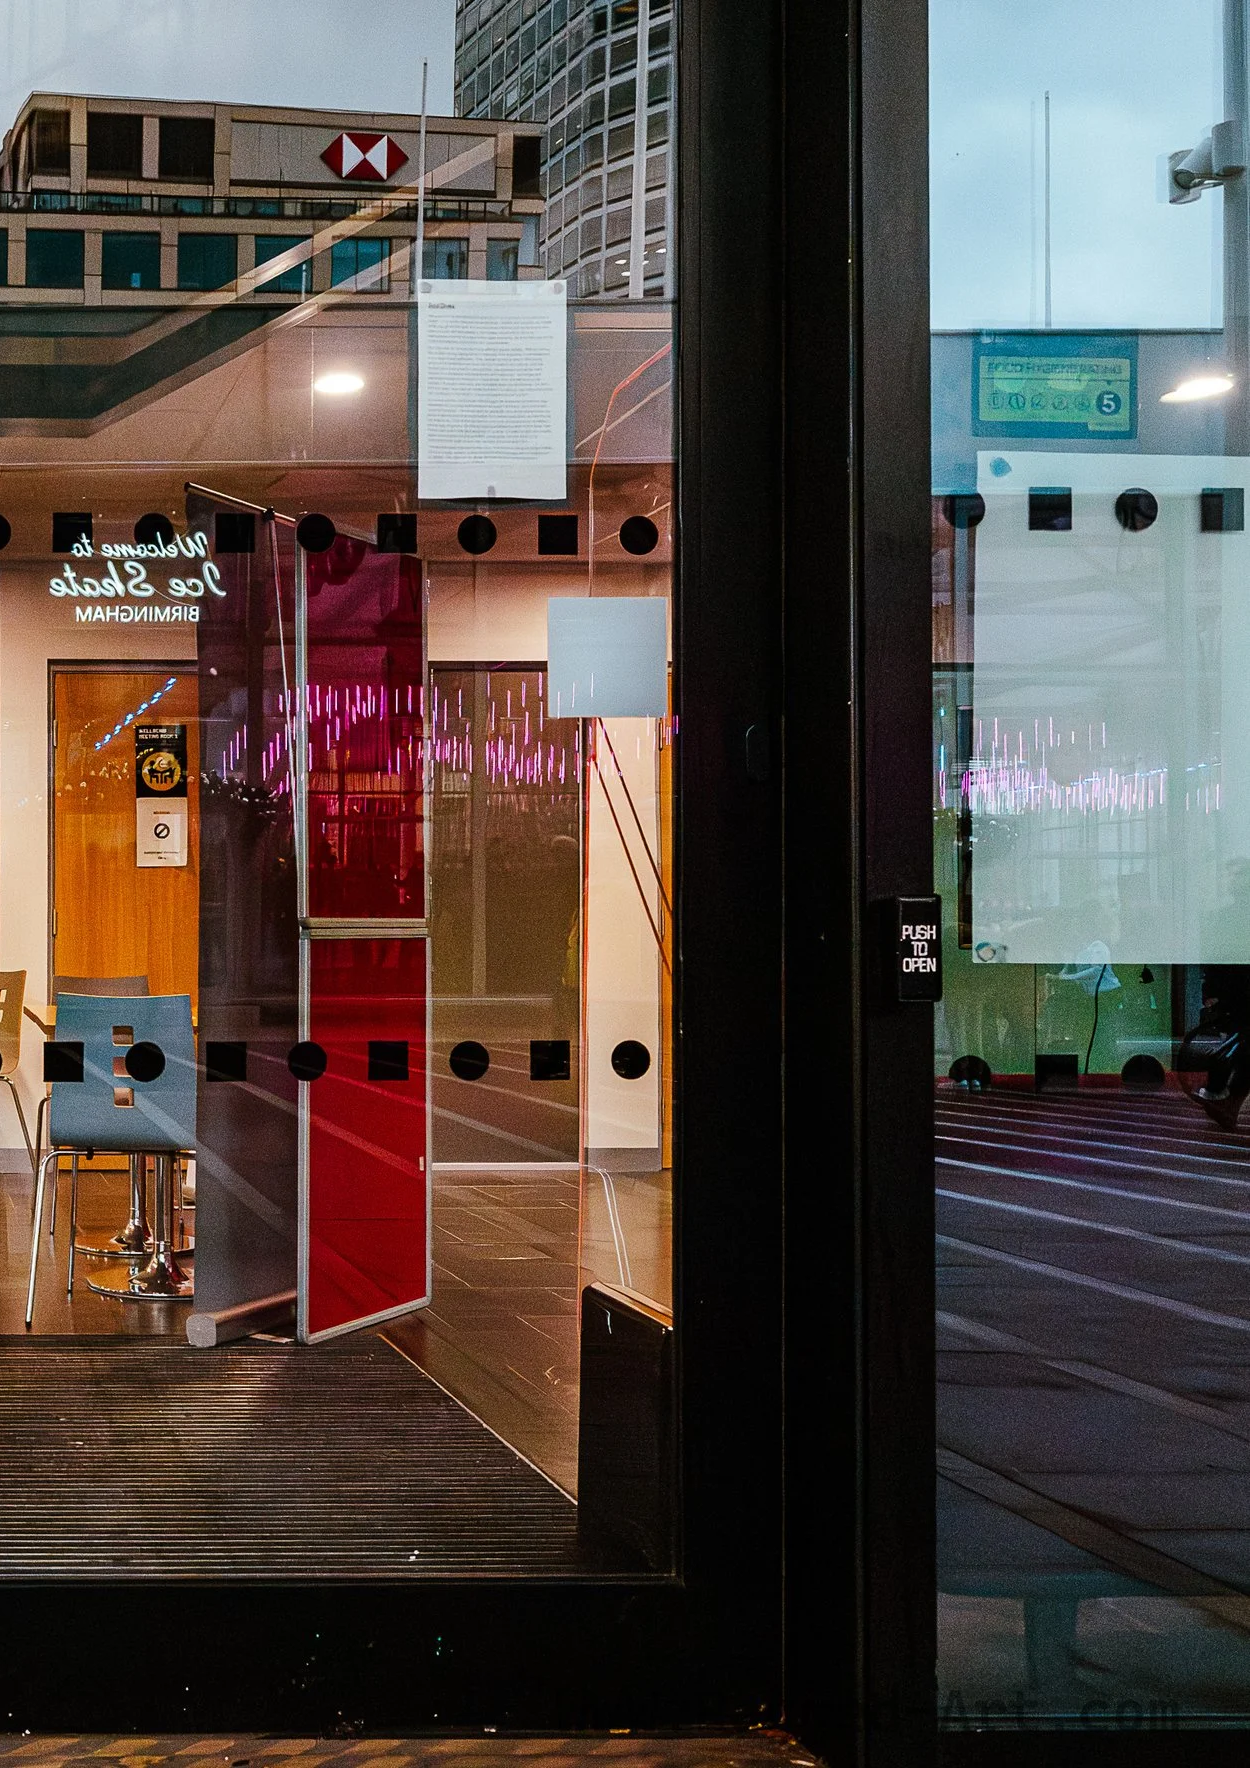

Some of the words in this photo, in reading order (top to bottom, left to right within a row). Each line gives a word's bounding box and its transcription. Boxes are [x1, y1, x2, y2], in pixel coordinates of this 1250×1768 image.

[1101, 394, 1116, 413] 5
[902, 925, 936, 940] PUSH
[911, 941, 928, 956] TO
[902, 957, 937, 972] OPEN
